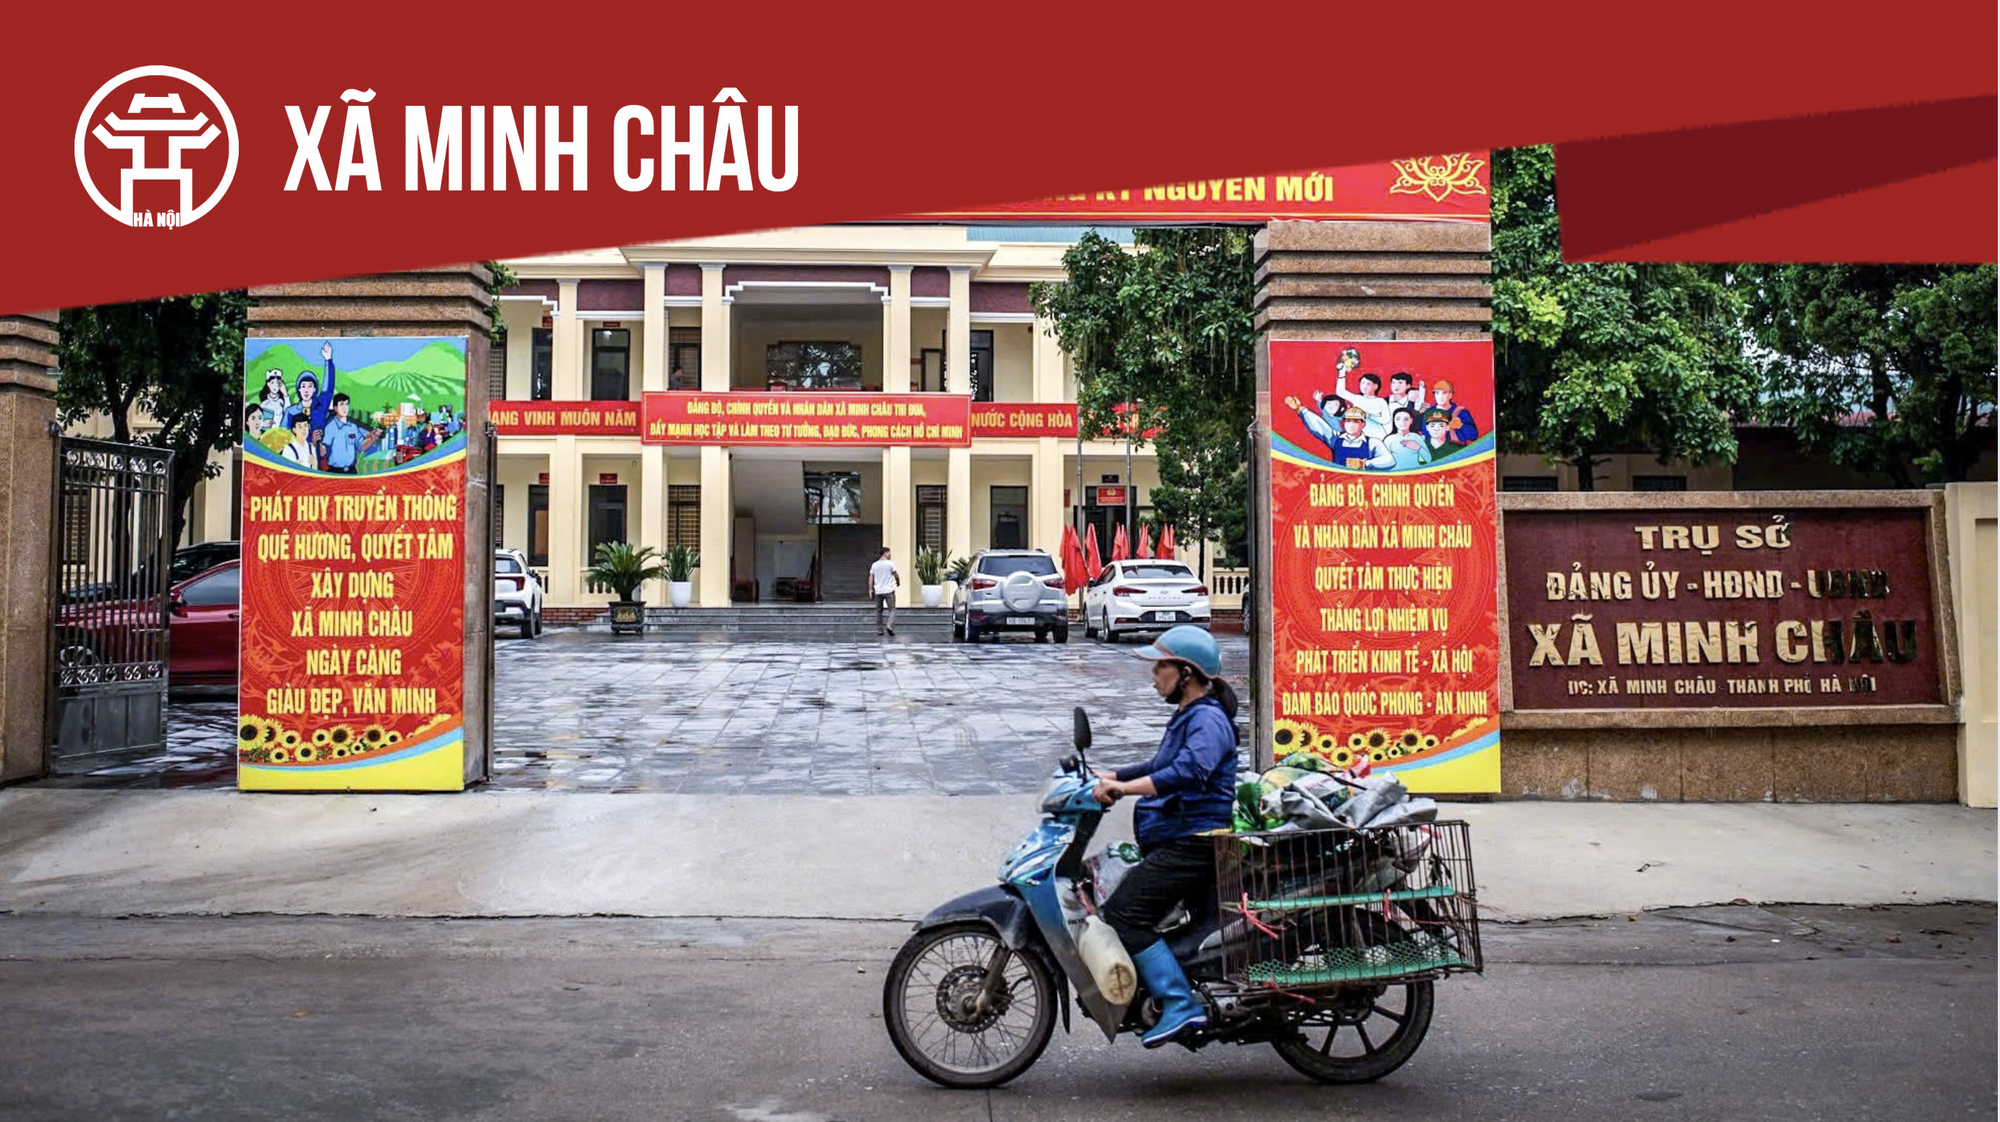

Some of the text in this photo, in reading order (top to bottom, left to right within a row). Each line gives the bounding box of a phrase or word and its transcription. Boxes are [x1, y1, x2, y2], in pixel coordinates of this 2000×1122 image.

[489, 407, 636, 426] ANG VINH MUÔN NĂM
[780, 400, 790, 415] VÀ
[848, 403, 869, 416] MINH
[894, 404, 906, 416] THI
[1009, 411, 1043, 431] CỘNG
[1048, 410, 1072, 428] HÒA
[729, 422, 739, 436] VÀ
[760, 424, 780, 437] THEO
[862, 425, 889, 438] PHONG
[890, 423, 912, 438] CÁCH
[941, 425, 963, 439] MINH
[251, 486, 457, 521] PHÁT HUY TRUYỀN THỐNG
[1310, 474, 1454, 512] ĐẢNG BỘ, CHÍNH QUYỀN
[258, 524, 453, 562] QUÊ HƯƠNG, QUYẾT TÂM
[1294, 520, 1471, 548] VÀ NHÂN DÂN XÃ MINH CHÂU
[1635, 515, 1792, 556] TRỤ SỞ
[311, 567, 393, 602] XÂY DỰNG
[1315, 559, 1452, 594] QUYẾT TÂM THỰC HIỆN
[1546, 562, 1632, 601] ĐẢNG
[1641, 561, 1680, 600] ỦY
[1703, 570, 1784, 600] HĐND
[292, 605, 412, 636] XÃ MINH CHÂU
[1321, 602, 1447, 636] THẮNG LỢI NHIỆM VỤ
[1528, 609, 1917, 667] XÃ MINH CHÂU
[307, 644, 401, 675] NGÀY CÀNG
[1296, 646, 1328, 673] PHÁT
[1332, 641, 1367, 673] TRIỂN
[1372, 650, 1401, 672] KINH
[1405, 642, 1419, 673] TẾ
[1432, 646, 1448, 673] XÃ
[1452, 645, 1472, 677] HỘI
[267, 683, 436, 719] GIÀU ĐẸP, VĂN MINH
[1283, 686, 1311, 715] ĐẢM
[1315, 682, 1339, 715] BẢO
[1344, 685, 1376, 717] QUỐC
[1381, 686, 1423, 715] PHÒNG
[1436, 692, 1453, 714] AN
[1457, 691, 1487, 714] NINH
[1597, 675, 1619, 695] XÃ
[1627, 678, 1668, 694] MINH
[1674, 675, 1717, 694] CHÂU
[1727, 676, 1780, 694] THÀNH
[1820, 675, 1842, 694] HÀ
